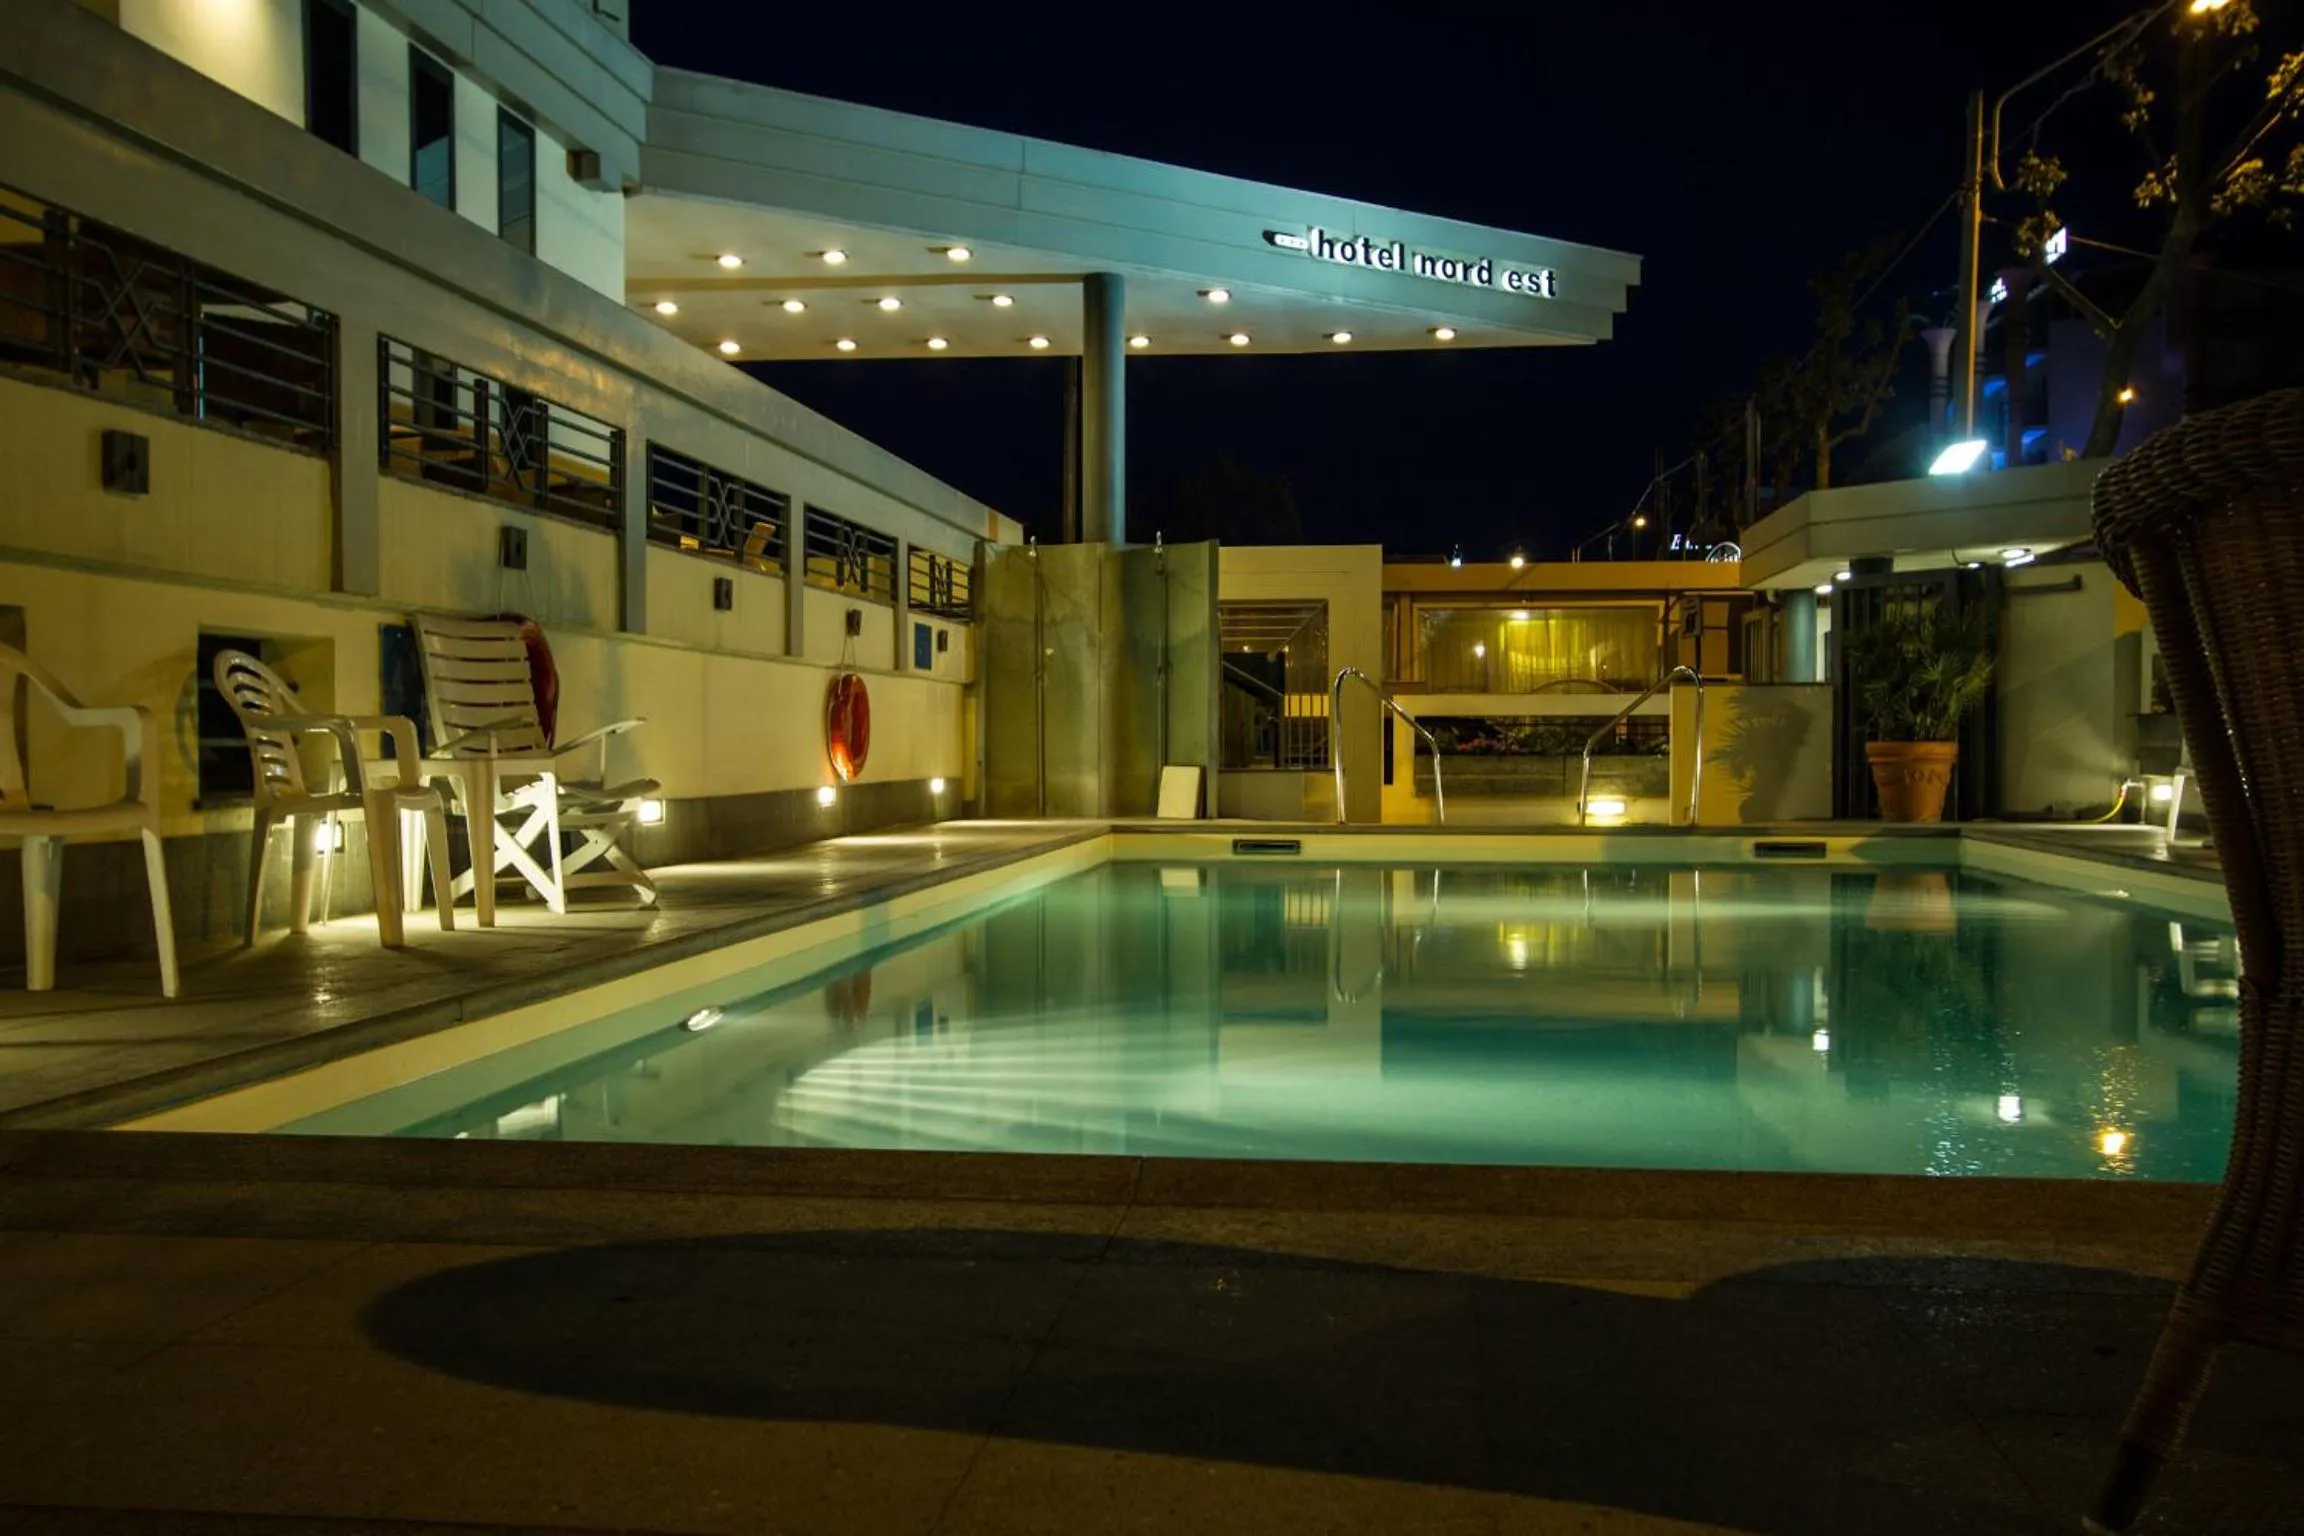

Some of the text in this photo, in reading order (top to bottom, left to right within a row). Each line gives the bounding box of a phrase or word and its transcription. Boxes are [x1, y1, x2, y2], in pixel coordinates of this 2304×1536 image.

[1309, 226, 1557, 299] hotel nord est
